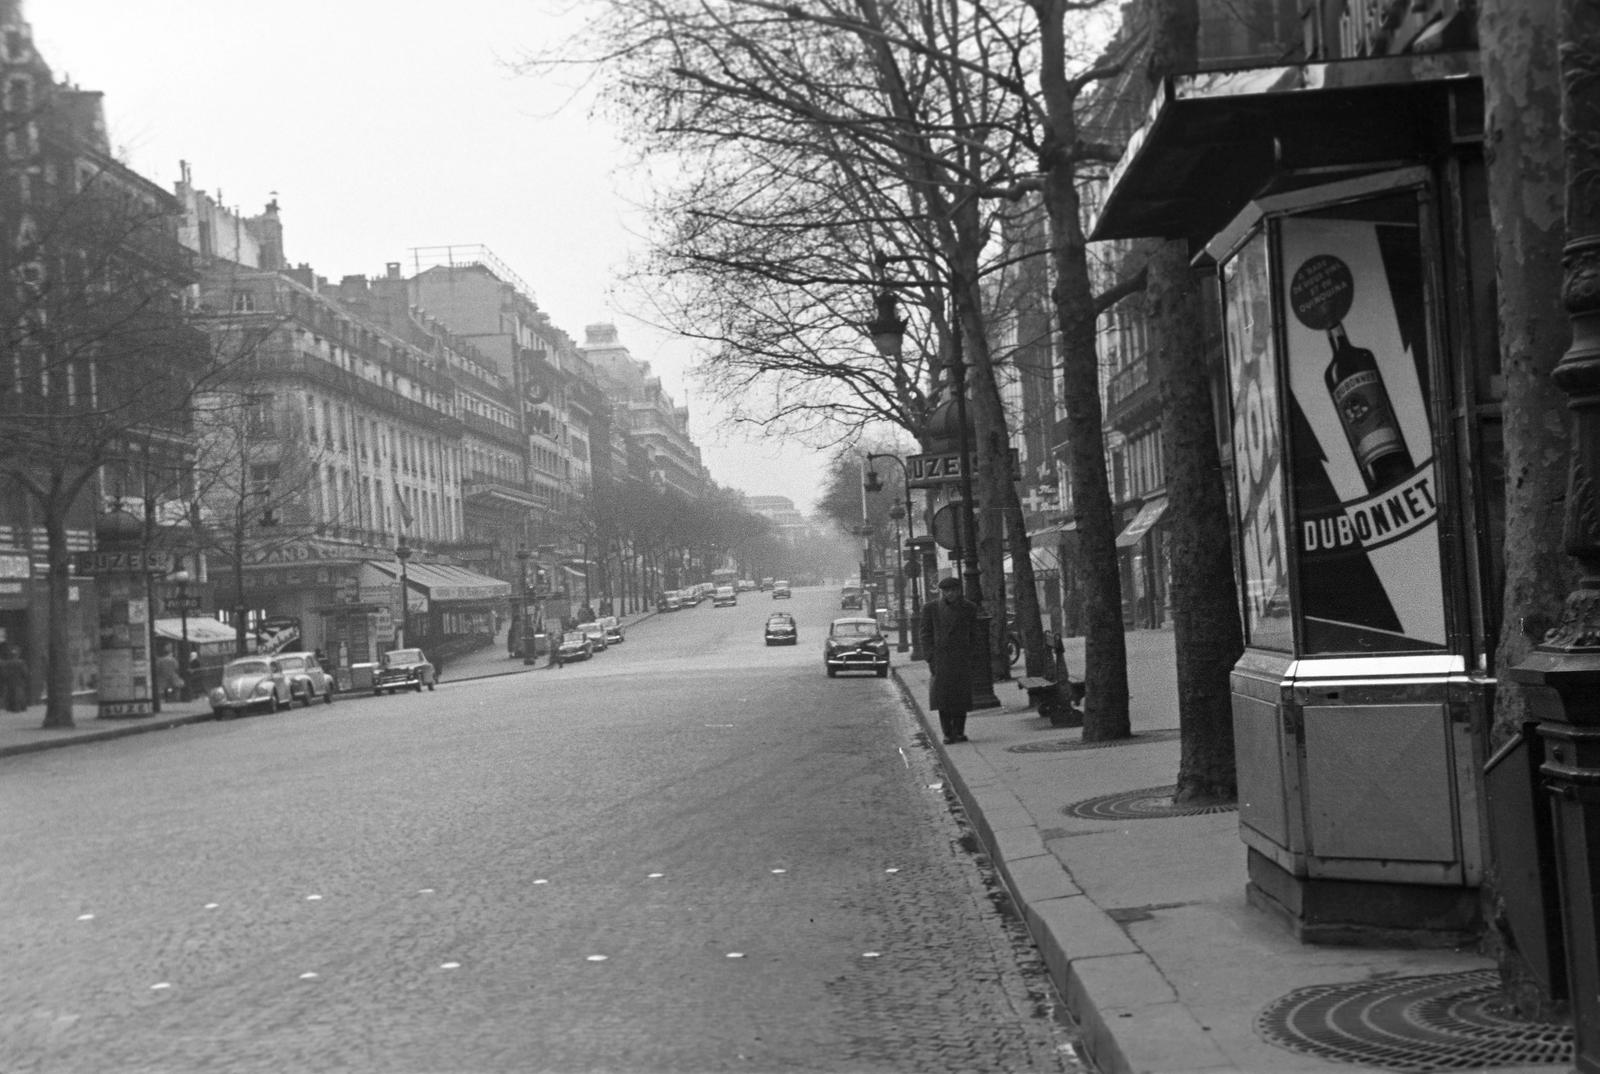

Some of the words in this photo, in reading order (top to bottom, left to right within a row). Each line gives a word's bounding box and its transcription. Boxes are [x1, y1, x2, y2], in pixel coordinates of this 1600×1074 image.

[1235, 332, 1280, 521] BON
[1244, 461, 1288, 632] NET
[1304, 478, 1436, 551] DUBONNET
[83, 553, 141, 570] SUZE
[104, 703, 145, 716] SUZE
